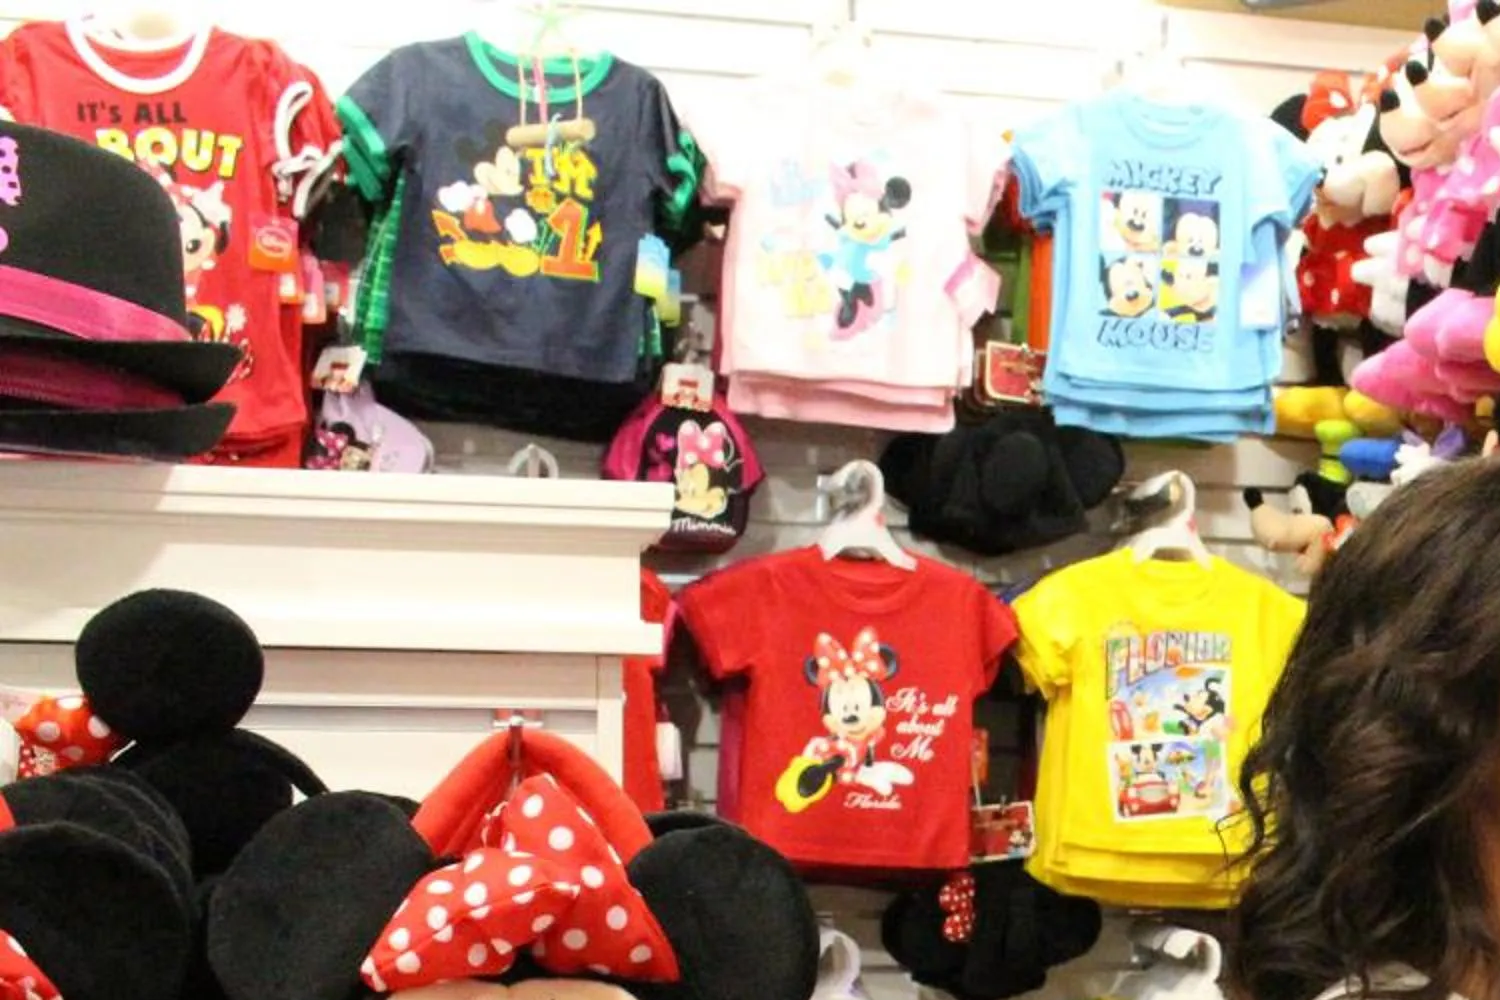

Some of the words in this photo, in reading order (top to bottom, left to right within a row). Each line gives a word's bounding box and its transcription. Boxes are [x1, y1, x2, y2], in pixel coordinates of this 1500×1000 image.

[77, 102, 122, 124] IT'S
[134, 102, 188, 124] ALL
[1103, 159, 1223, 197] MICKEY
[1096, 317, 1217, 353] MOUSE
